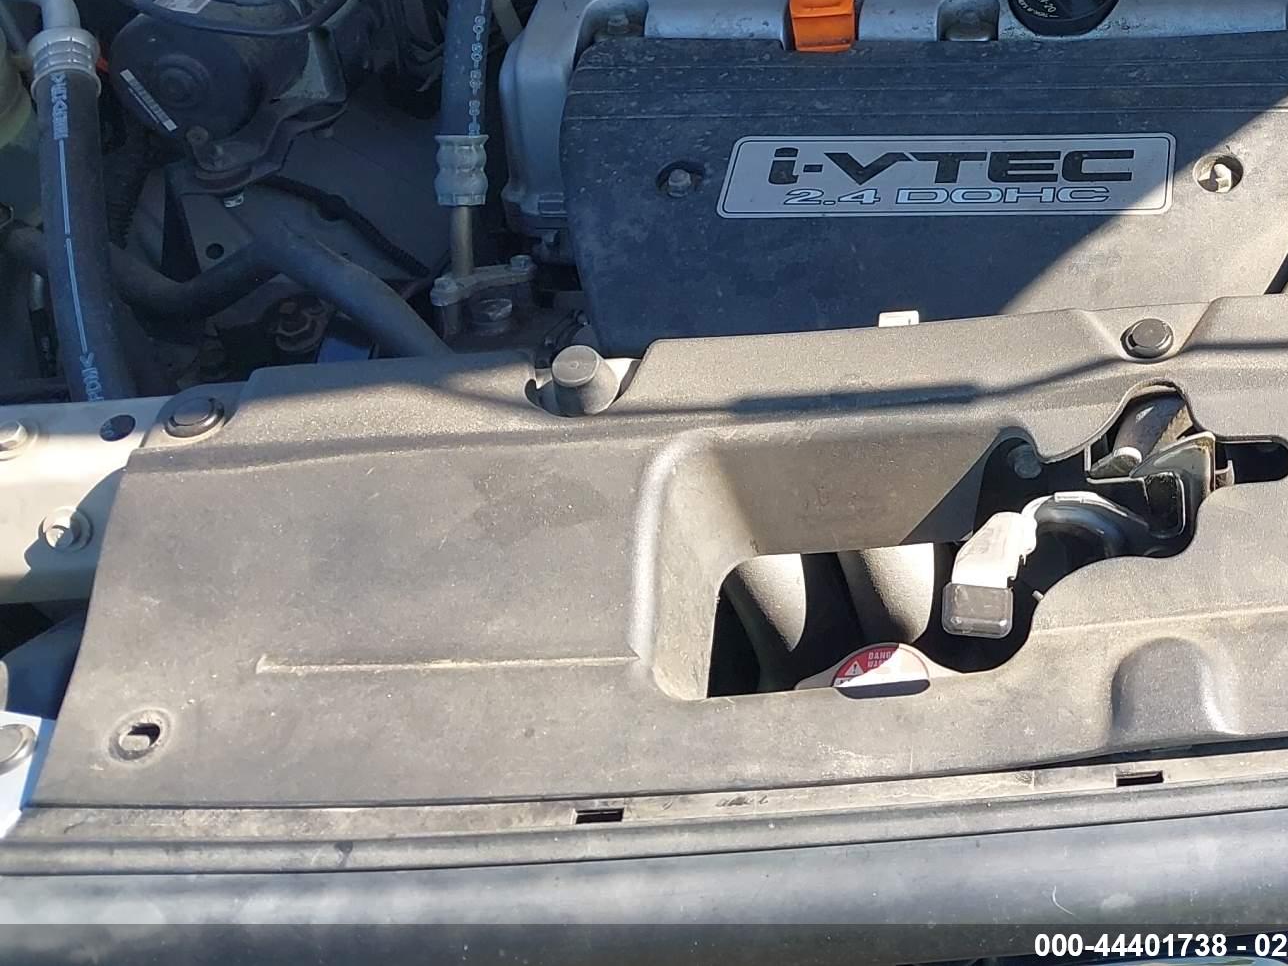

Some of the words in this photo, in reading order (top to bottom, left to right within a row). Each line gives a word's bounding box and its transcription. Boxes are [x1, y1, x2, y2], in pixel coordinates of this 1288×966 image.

[767, 148, 1136, 186] i-VTEC
[782, 187, 882, 206] 2.4
[895, 186, 1112, 205] DOHC
